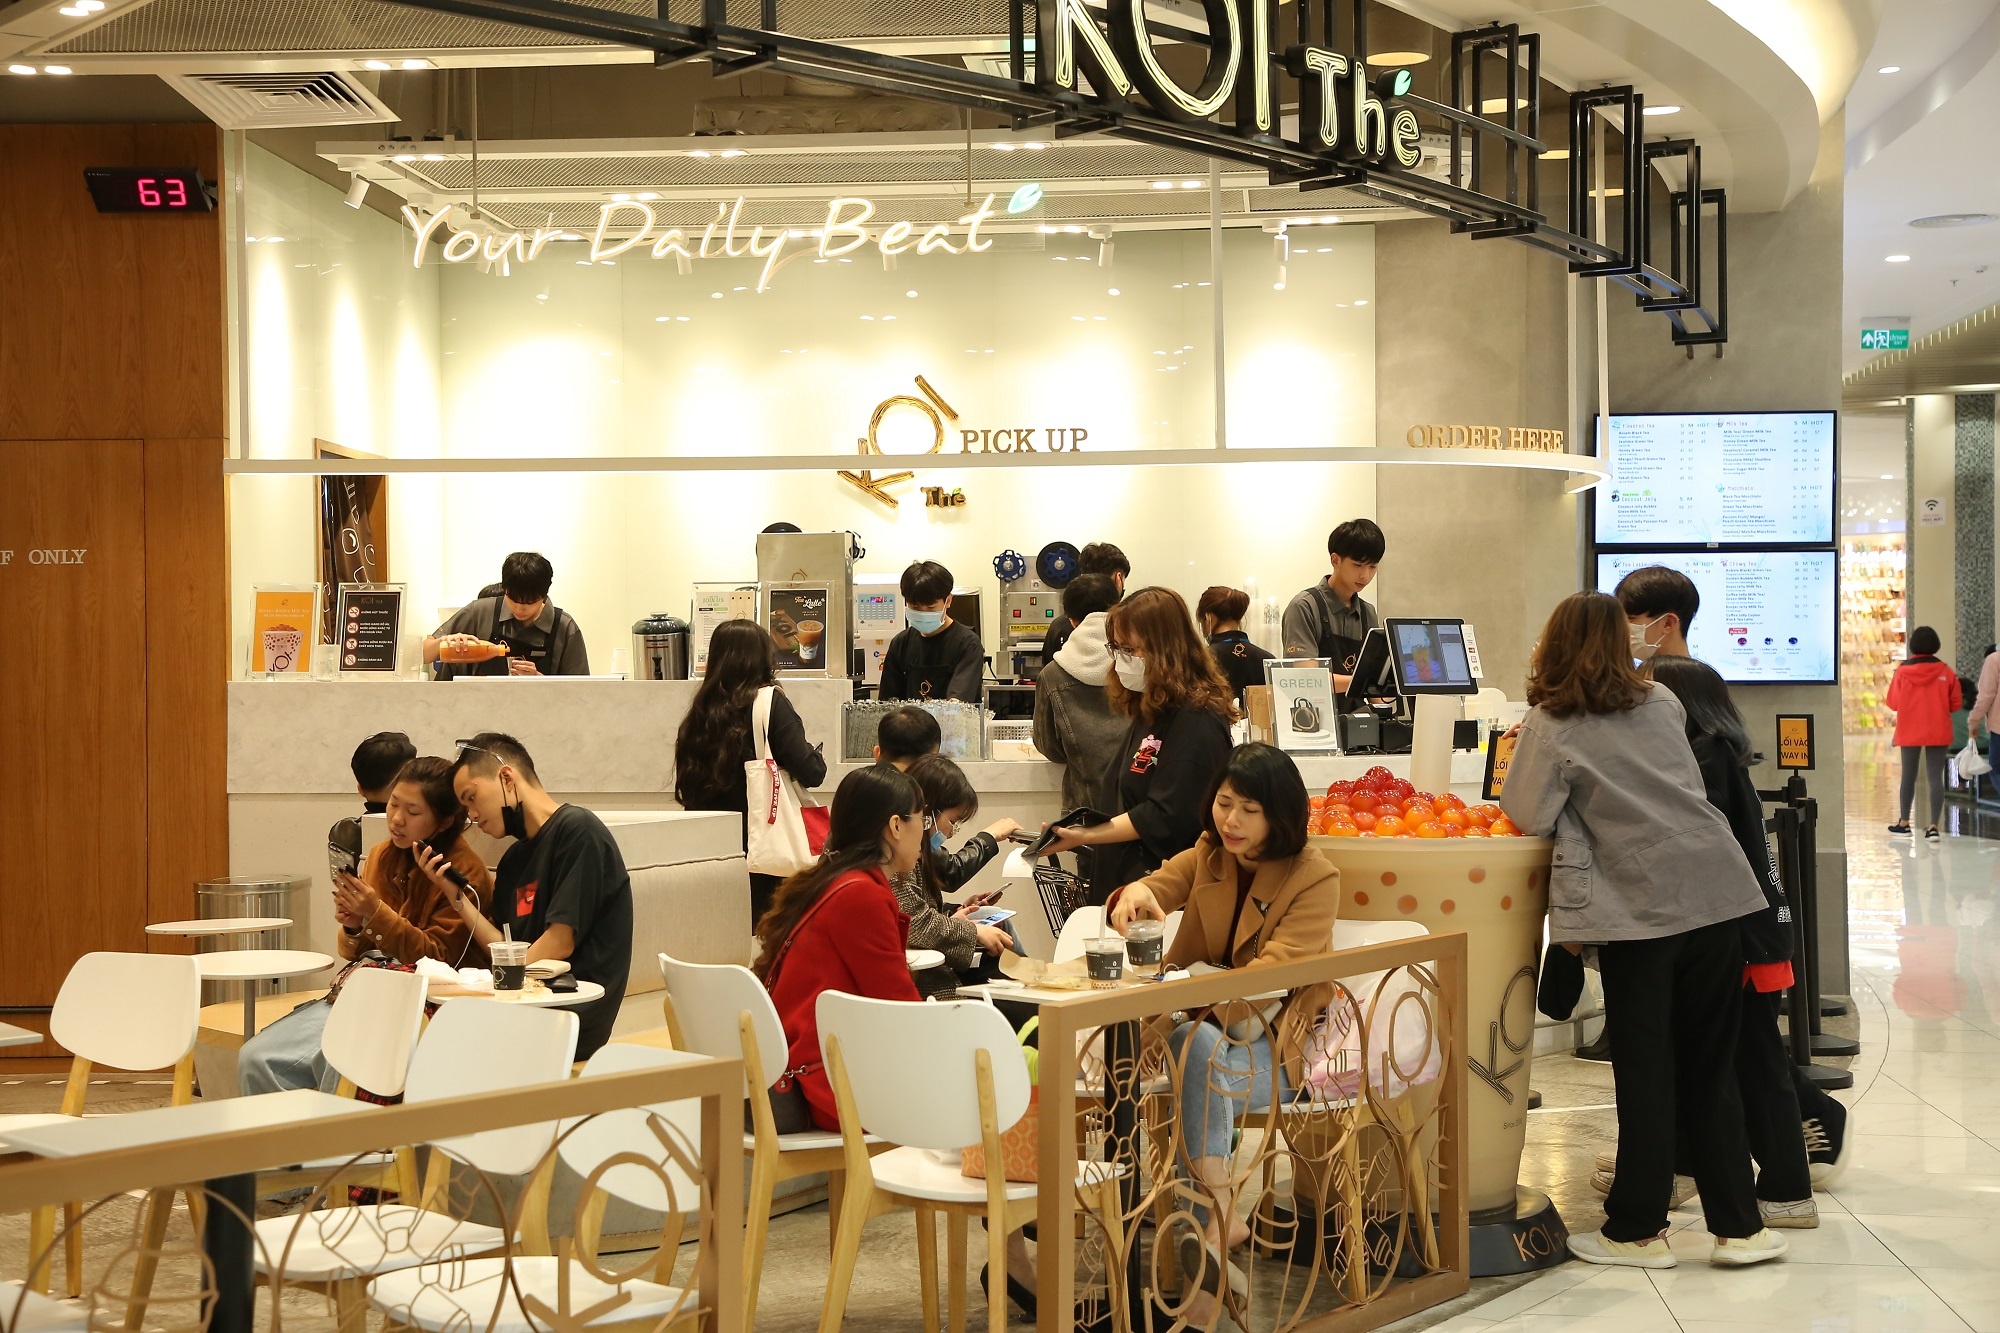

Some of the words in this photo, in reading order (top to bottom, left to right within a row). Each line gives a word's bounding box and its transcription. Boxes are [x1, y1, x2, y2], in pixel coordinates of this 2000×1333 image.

[137, 179, 187, 206] 63
[400, 203, 562, 268] Your
[589, 194, 790, 294] Daily
[819, 194, 996, 259] Beat
[960, 428, 1036, 454] PICK
[1046, 427, 1089, 453] UP
[1406, 423, 1503, 450] ORDER
[1506, 426, 1564, 454] HERE
[28, 549, 88, 565] ONLY
[1279, 679, 1323, 688] GREEN
[1512, 1223, 1557, 1262] KOI
